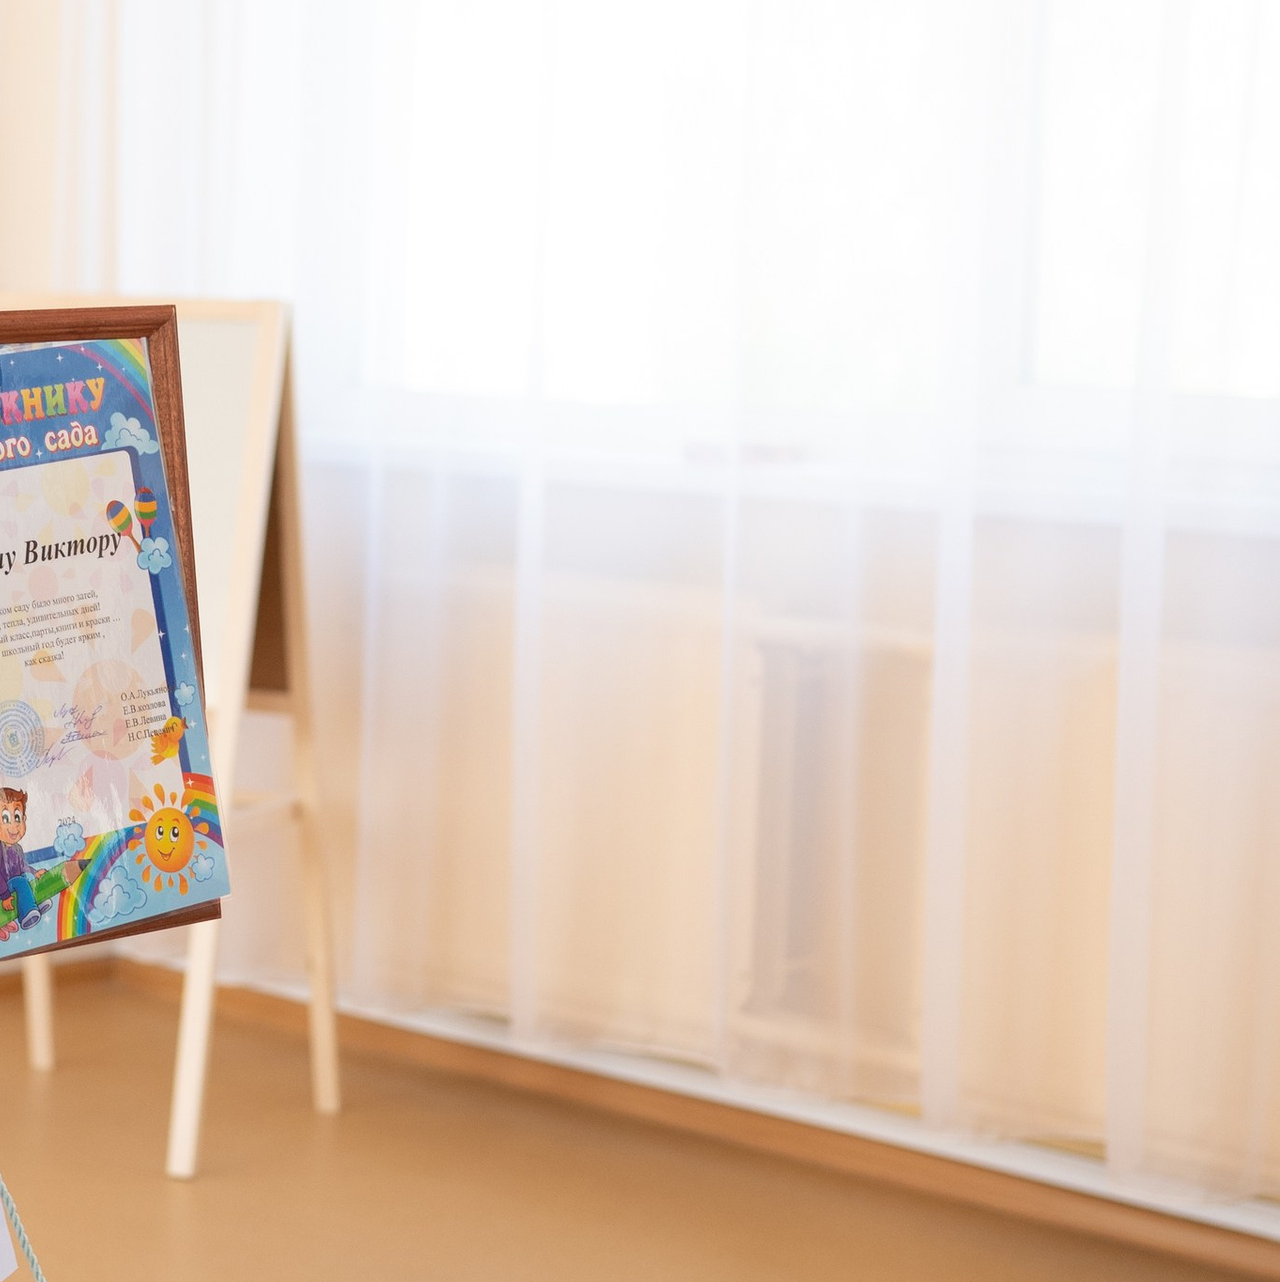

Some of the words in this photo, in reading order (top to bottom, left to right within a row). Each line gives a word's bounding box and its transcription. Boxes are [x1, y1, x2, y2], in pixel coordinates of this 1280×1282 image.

[44, 421, 99, 452] сада
[23, 532, 121, 566] Виктору
[14, 603, 30, 613] саду
[32, 600, 51, 609] было
[52, 595, 75, 605] много
[76, 590, 98, 601] затей,
[3, 618, 26, 629] тепла,
[26, 608, 79, 626] удивительных
[81, 602, 101, 614] дней!
[85, 616, 111, 628] краски
[1, 642, 40, 657] школьный
[41, 641, 55, 649] год
[55, 636, 76, 648] будет
[24, 658, 37, 667] как
[38, 651, 65, 664] сказка!
[57, 815, 76, 827] 2024
